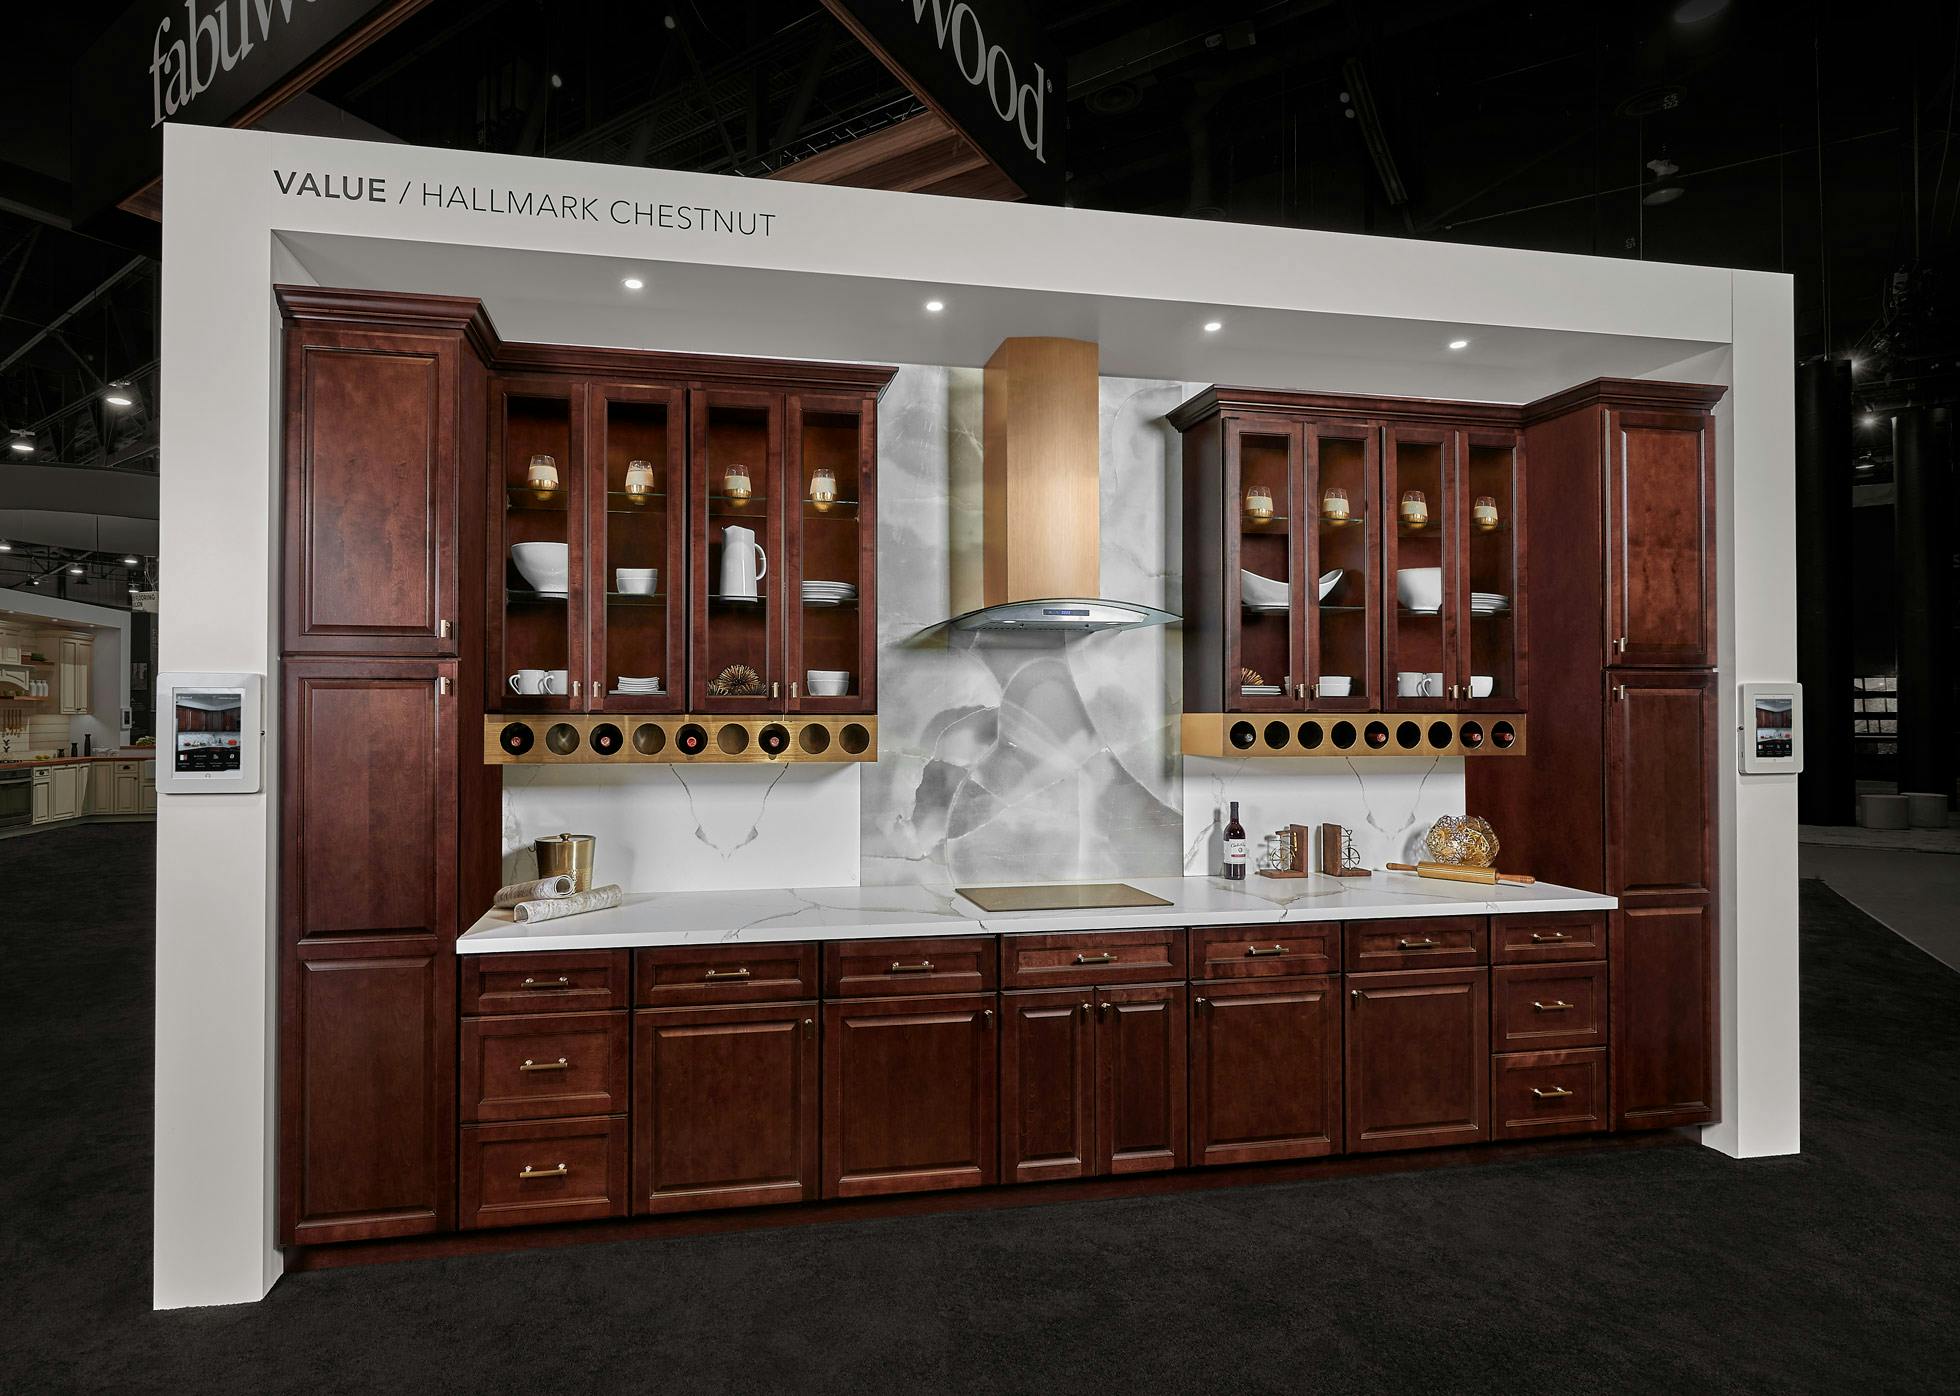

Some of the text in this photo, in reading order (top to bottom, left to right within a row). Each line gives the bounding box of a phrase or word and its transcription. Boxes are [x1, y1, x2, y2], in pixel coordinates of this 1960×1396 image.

[149, 0, 317, 129] fabuw
[273, 169, 387, 203] VALUE
[422, 182, 599, 222] HALLMARK
[609, 199, 777, 237] CHESTNUT
